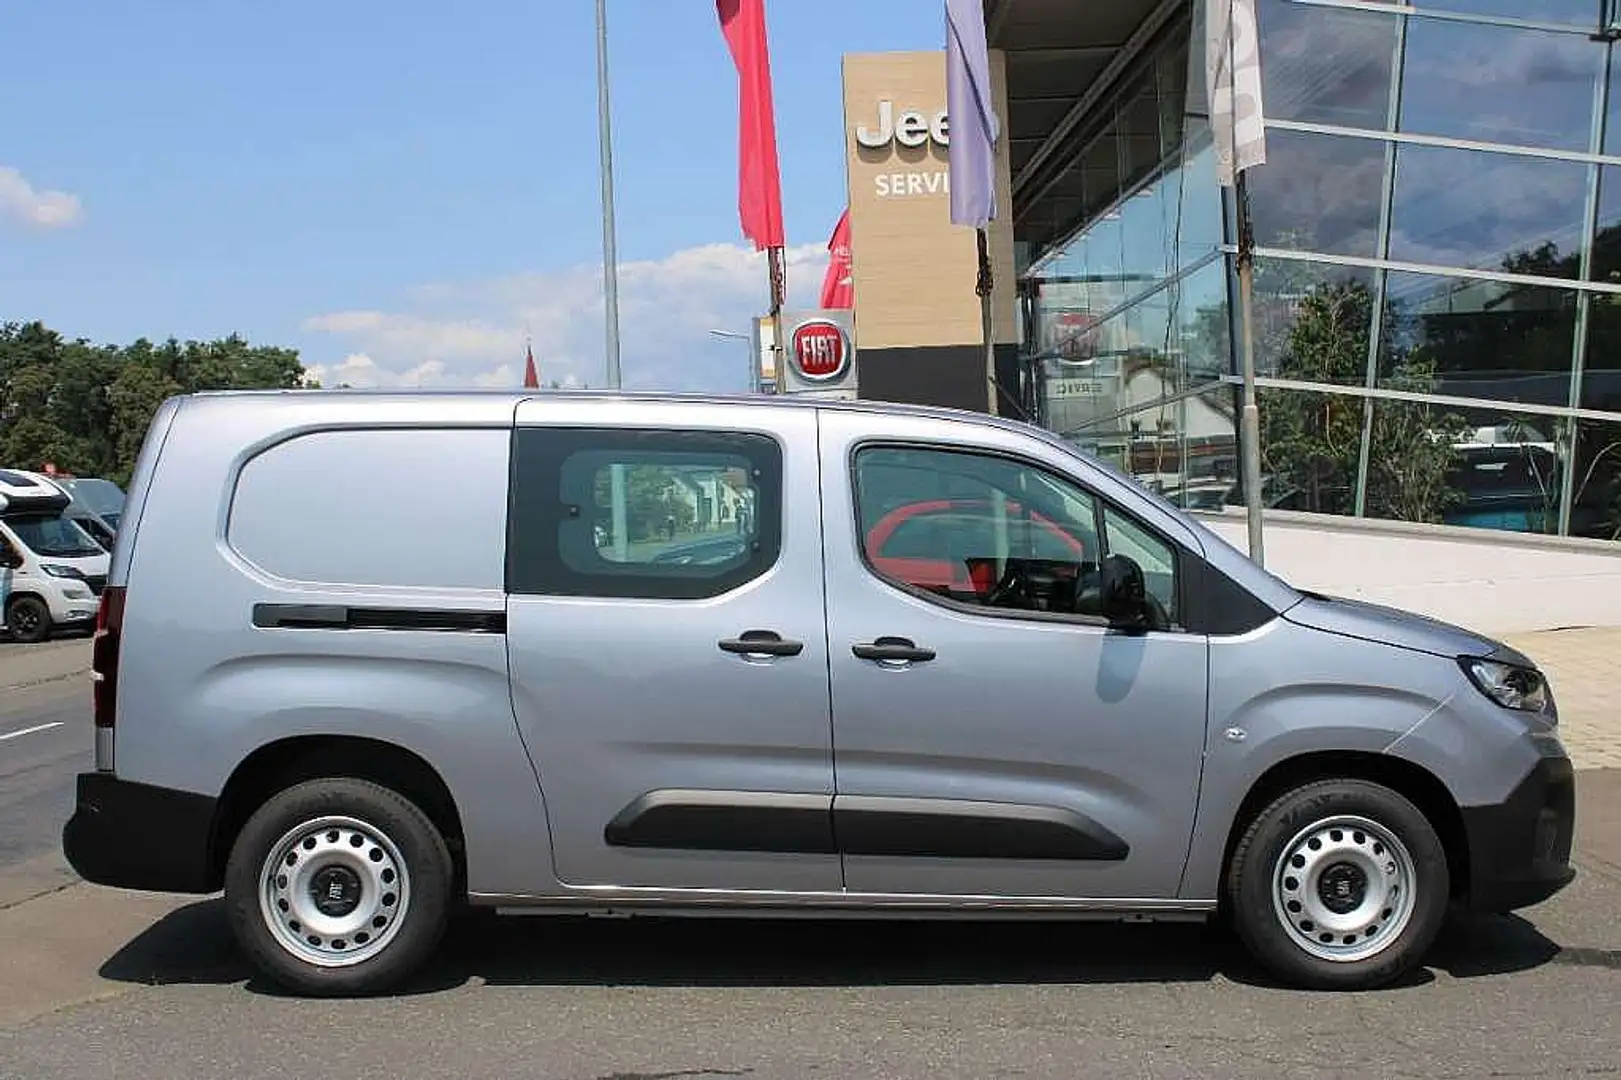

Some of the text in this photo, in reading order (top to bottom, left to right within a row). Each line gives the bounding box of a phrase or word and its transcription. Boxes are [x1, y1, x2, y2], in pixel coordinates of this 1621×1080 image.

[856, 100, 999, 147] Jee
[874, 173, 950, 196] SERVI
[801, 335, 837, 365] FIAT
